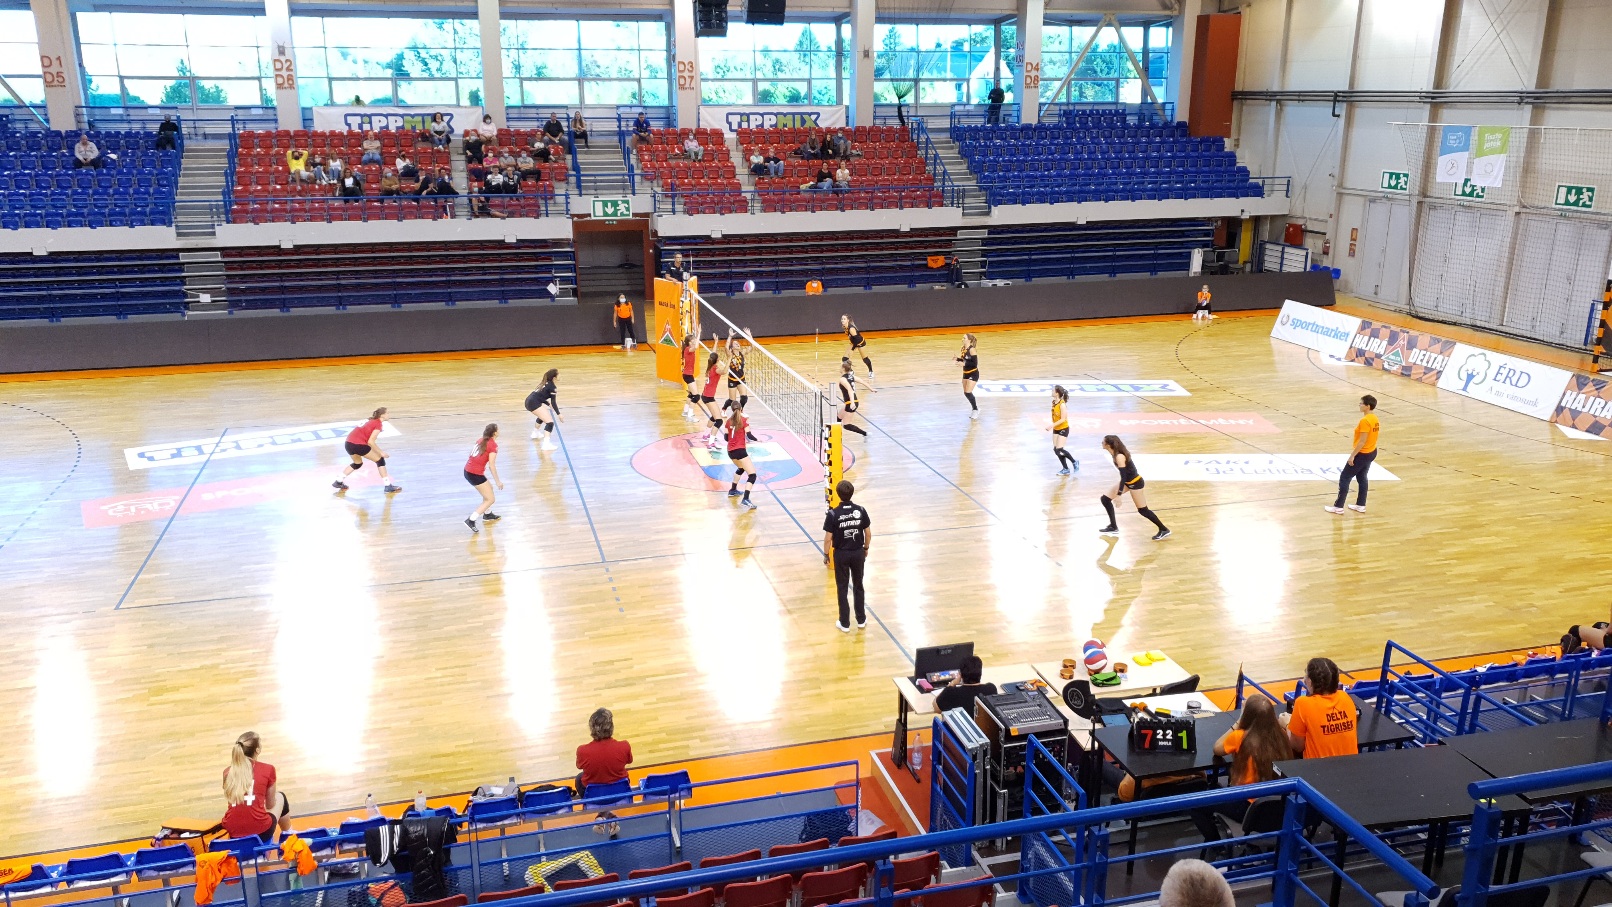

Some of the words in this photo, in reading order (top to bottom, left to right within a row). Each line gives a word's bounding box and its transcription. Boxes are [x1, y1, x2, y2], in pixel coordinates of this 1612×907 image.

[41, 55, 62, 68] D1
[273, 58, 293, 72] D2
[677, 60, 695, 73] D3
[1025, 61, 1040, 73] D4
[43, 71, 66, 84] D5
[275, 73, 295, 86] D6
[677, 75, 695, 87] D7
[1024, 74, 1040, 86] D8
[1289, 316, 1351, 343] sportmarket
[1352, 333, 1389, 356] HAJRÁ
[1408, 347, 1451, 371] DELTA!
[1492, 363, 1532, 389] ÉRD
[1486, 385, 1494, 395] A
[1326, 710, 1348, 722] DELTA
[1141, 730, 1153, 749] 7
[1177, 730, 1188, 749] 1
